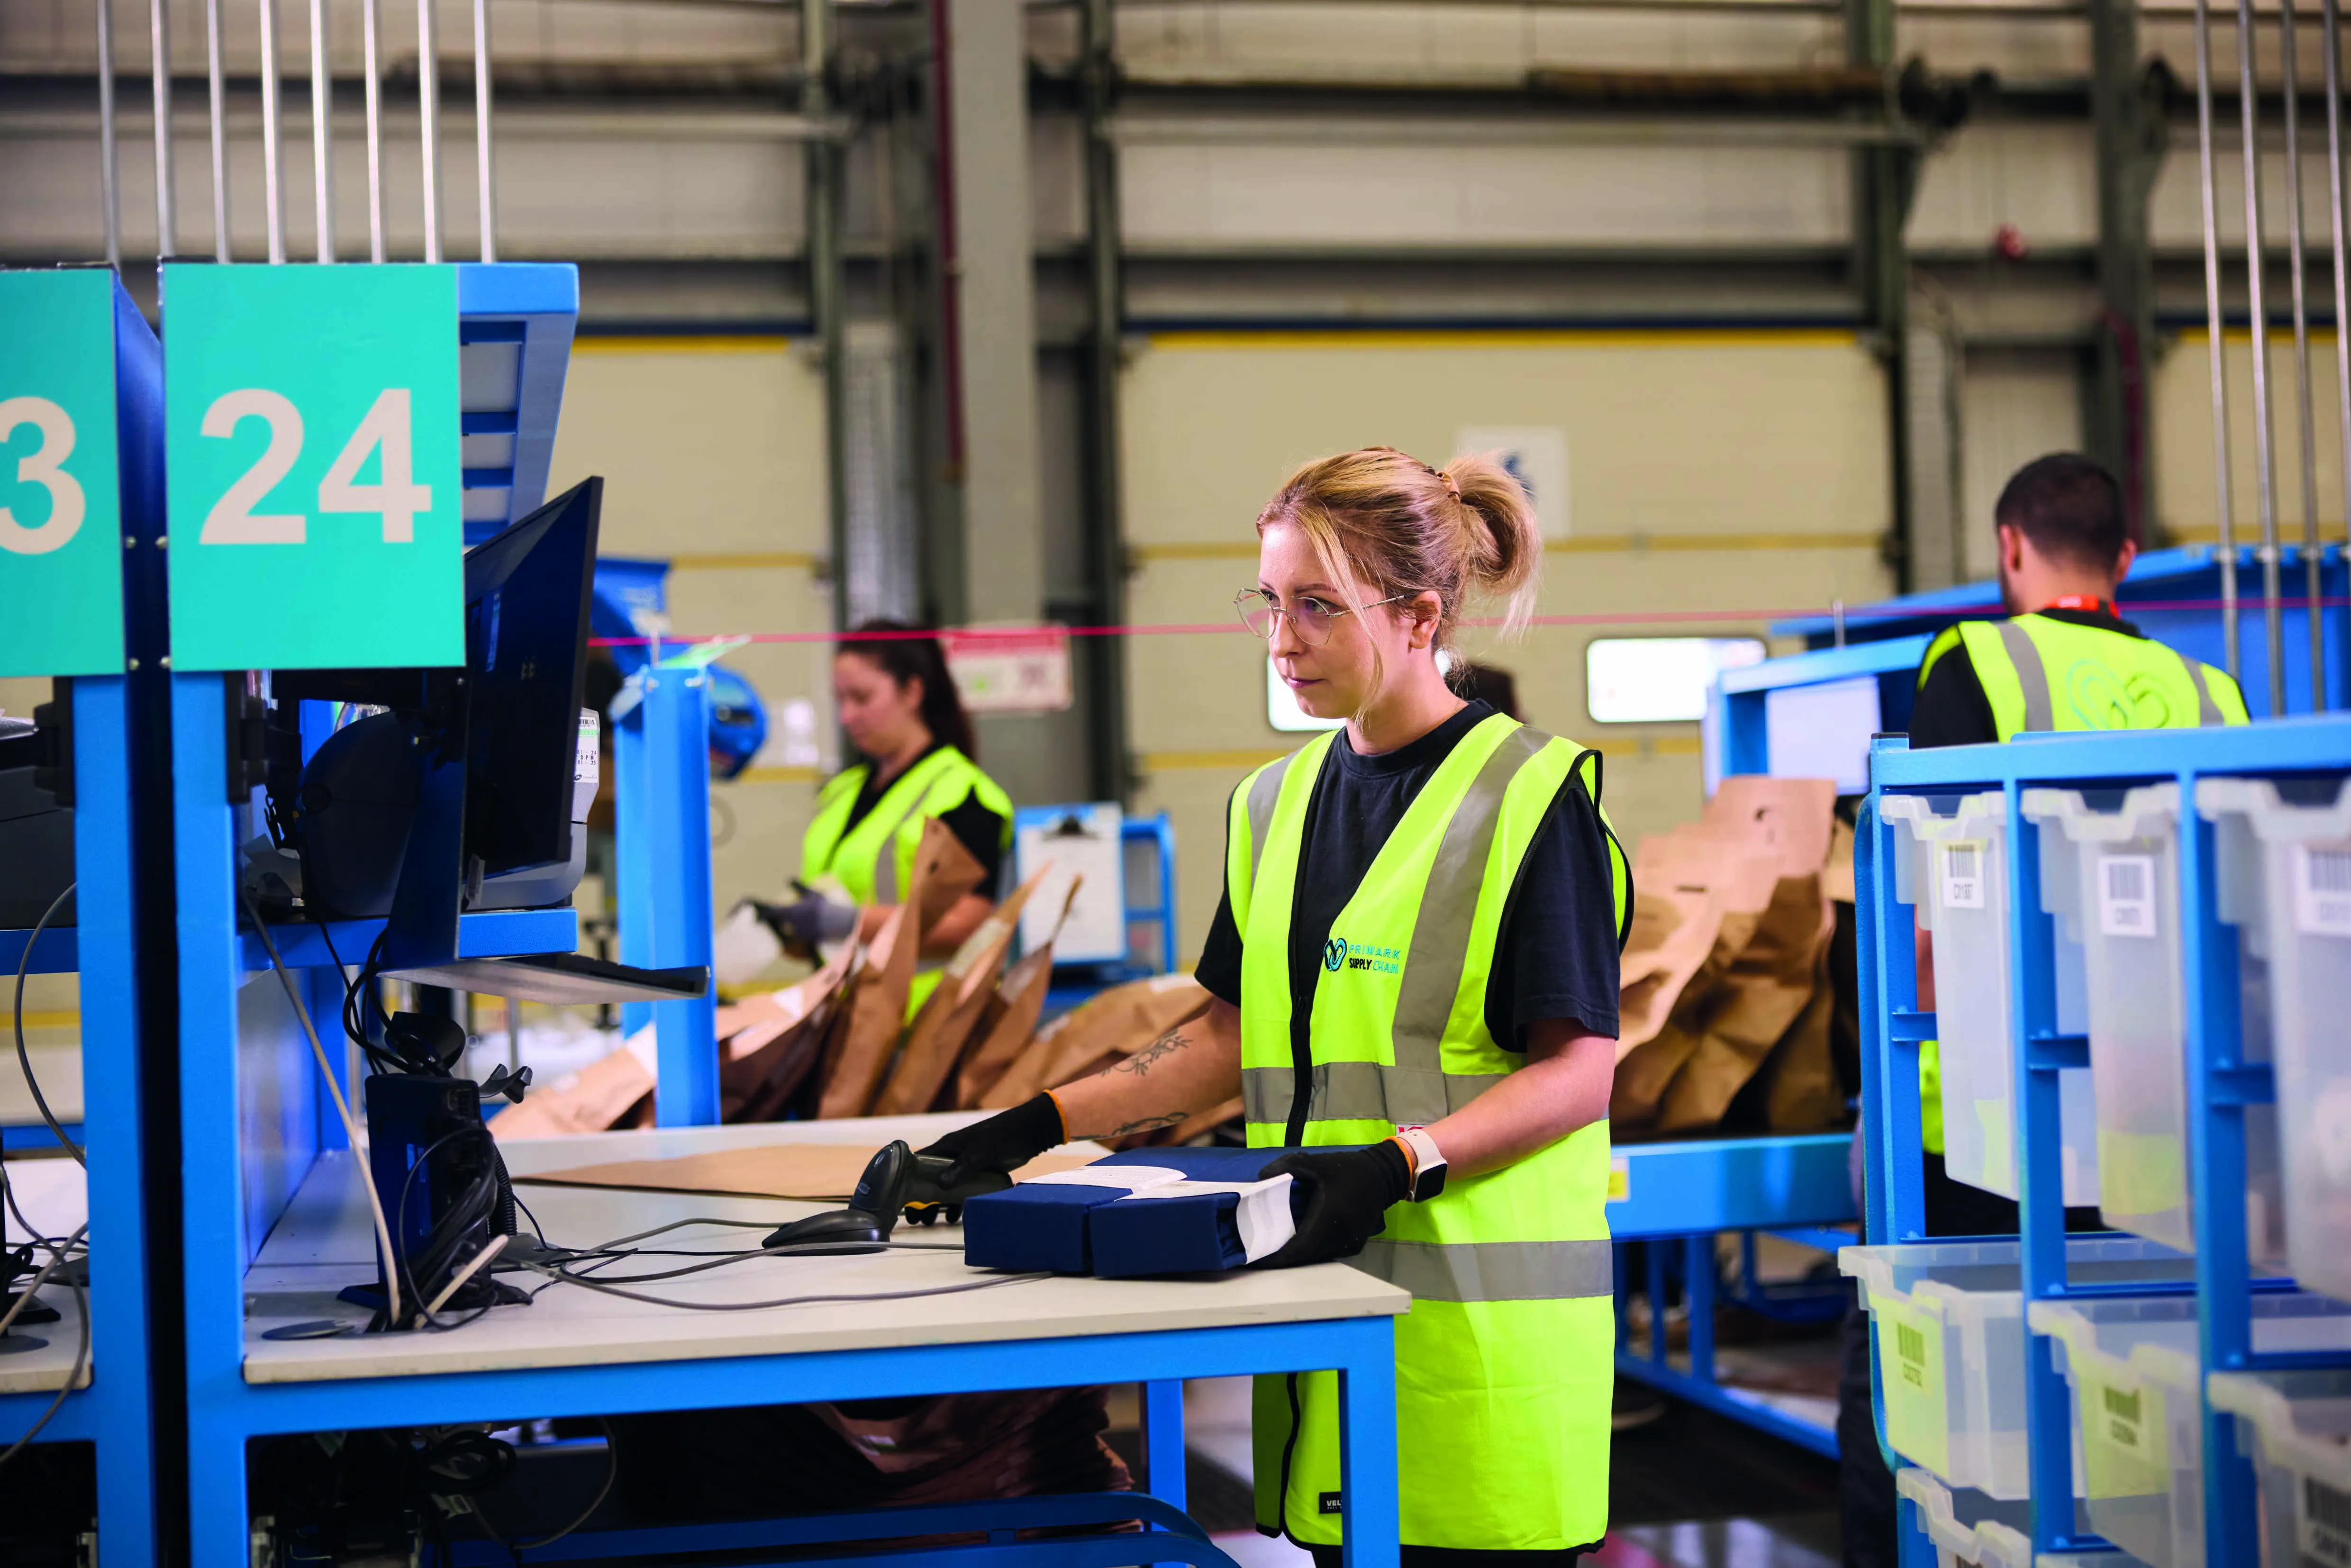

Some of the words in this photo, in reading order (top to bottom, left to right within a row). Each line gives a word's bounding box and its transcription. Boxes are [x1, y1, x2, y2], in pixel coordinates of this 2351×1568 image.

[199, 388, 432, 545] 24
[1349, 943, 1401, 960] PRIMARK
[1349, 958, 1372, 970] SUPPLY
[1373, 961, 1399, 974] CHAIN
